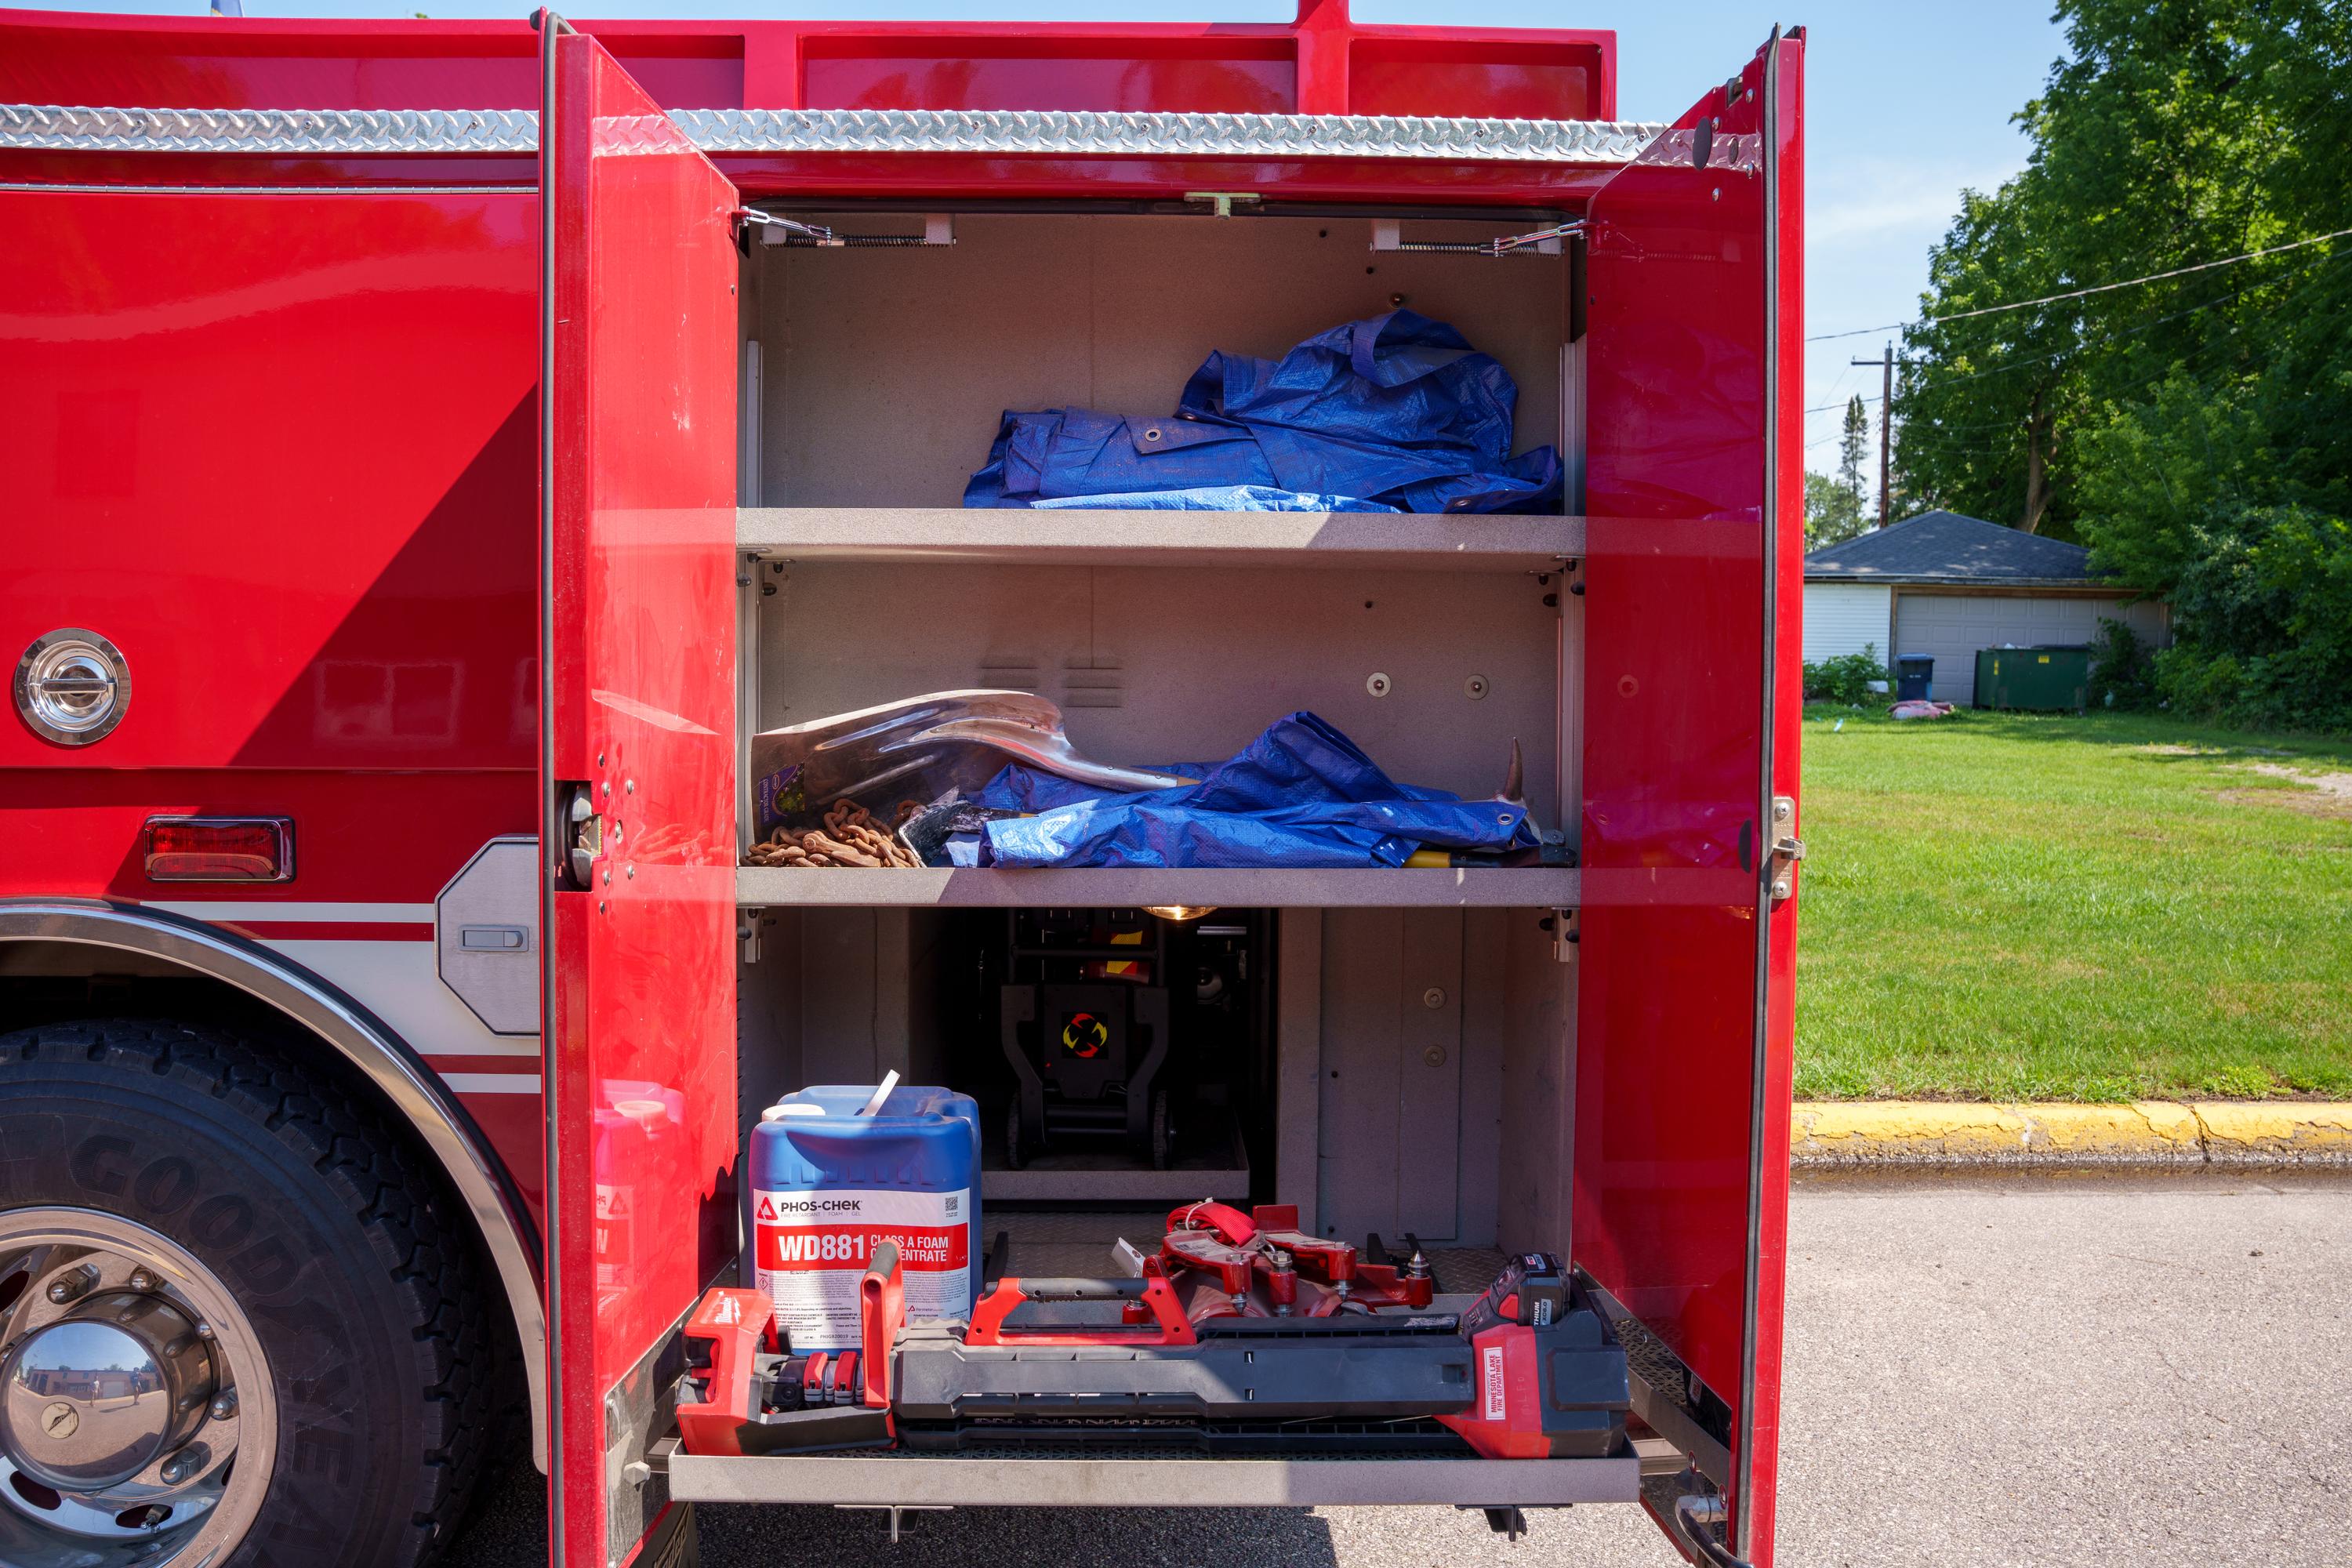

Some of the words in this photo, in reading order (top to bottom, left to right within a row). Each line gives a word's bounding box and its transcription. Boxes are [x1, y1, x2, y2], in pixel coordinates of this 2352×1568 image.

[778, 1234, 865, 1261] WD881
[907, 1236, 915, 1248] A
[917, 1236, 949, 1249] FOAM
